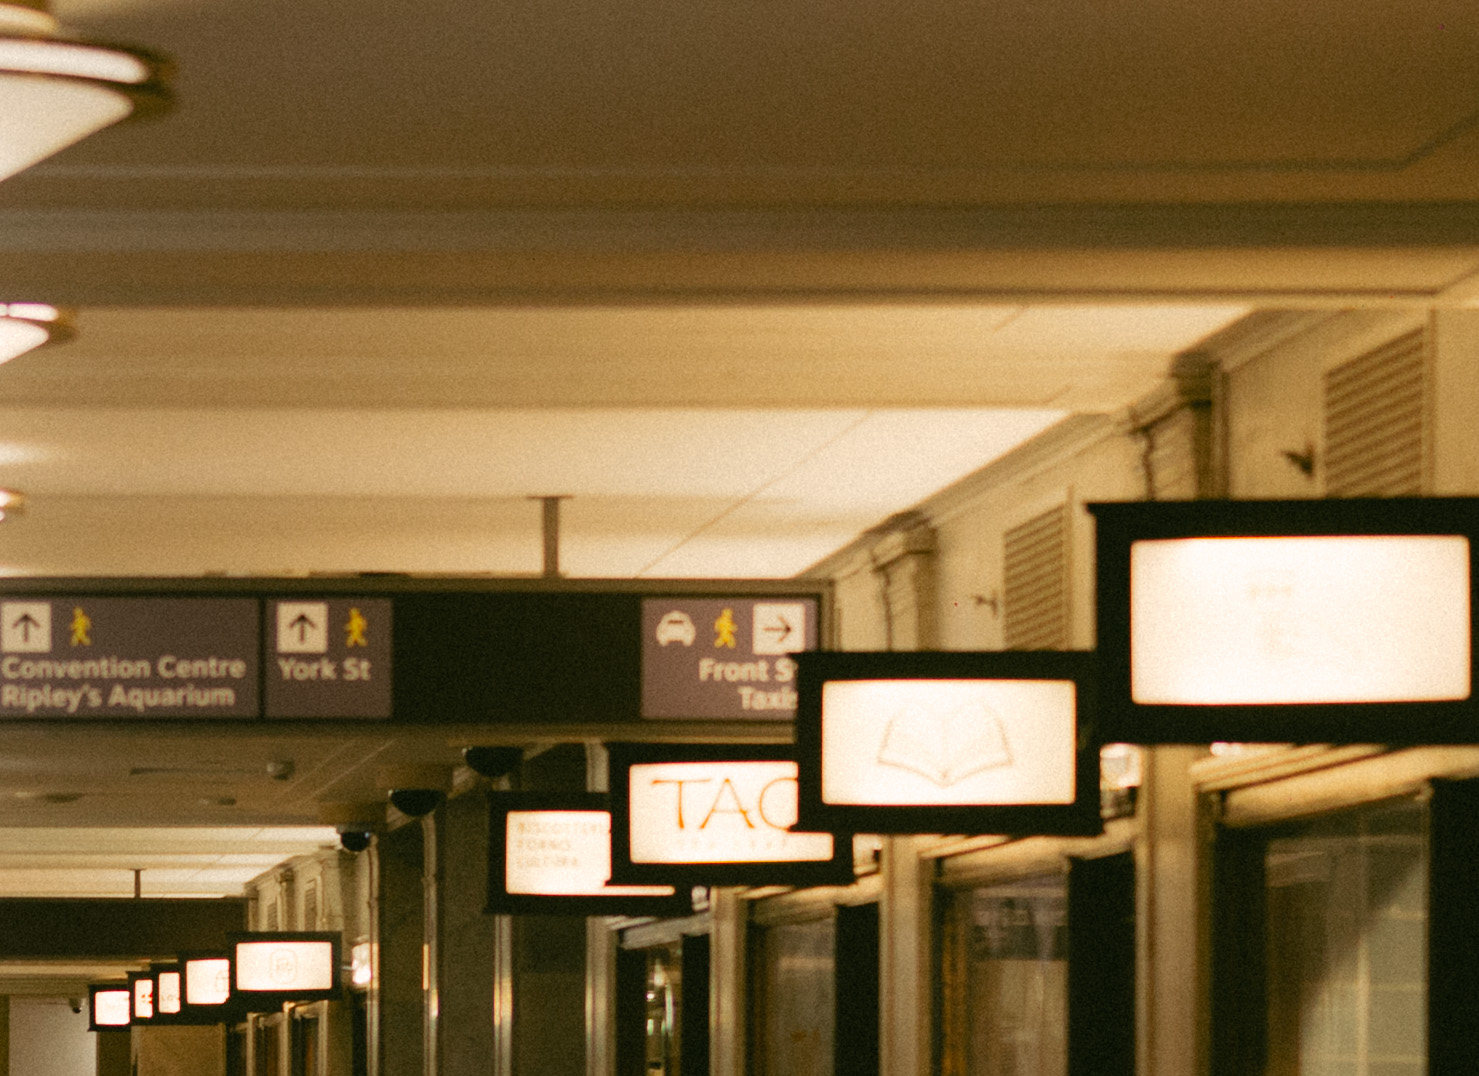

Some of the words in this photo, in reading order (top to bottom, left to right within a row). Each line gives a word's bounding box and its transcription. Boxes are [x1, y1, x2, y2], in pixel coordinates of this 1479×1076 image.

[0, 656, 150, 680] Convention
[158, 656, 246, 680] Centre
[277, 658, 337, 681] York
[343, 658, 371, 681] St
[699, 657, 769, 682] Front
[774, 657, 798, 682] S
[1, 684, 103, 713] Ripley's
[108, 685, 235, 713] Aquarium
